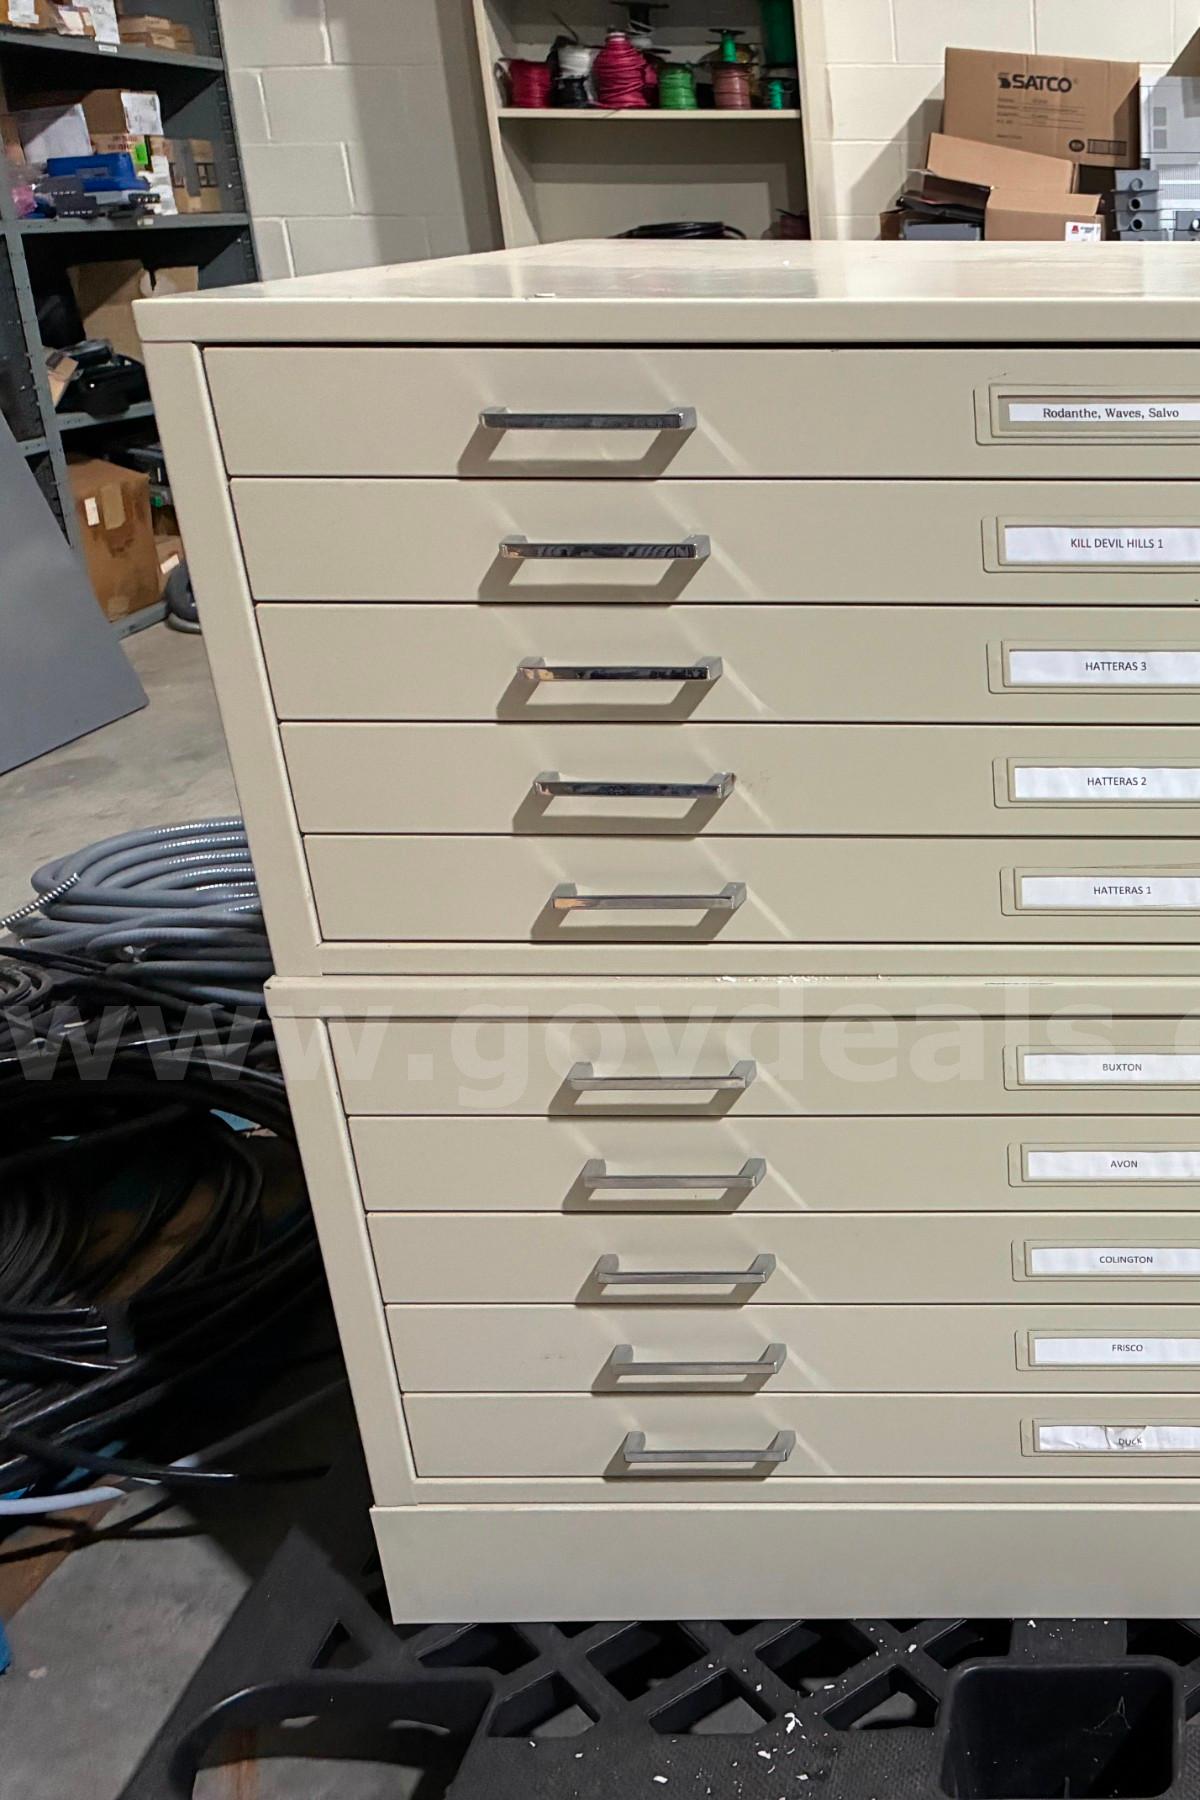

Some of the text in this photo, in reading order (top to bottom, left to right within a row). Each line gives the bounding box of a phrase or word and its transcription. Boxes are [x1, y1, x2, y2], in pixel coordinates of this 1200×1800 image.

[1012, 74, 1072, 94] SATCO
[1042, 407, 1180, 419] Rodanthe, Waves, Salvo
[1070, 538, 1164, 549] KILL DEVIL HILLS 1
[1085, 661, 1147, 672] HATTERAS 3
[1087, 776, 1147, 787] HATTERAS 2
[1093, 885, 1152, 895] HATTERAS 1
[1102, 1063, 1142, 1072] BUXTON
[1110, 1159, 1138, 1169] AVON
[1099, 1255, 1154, 1265] COLINGTON
[1111, 1344, 1144, 1353] FRISCO
[1118, 1437, 1143, 1448] DUCK
